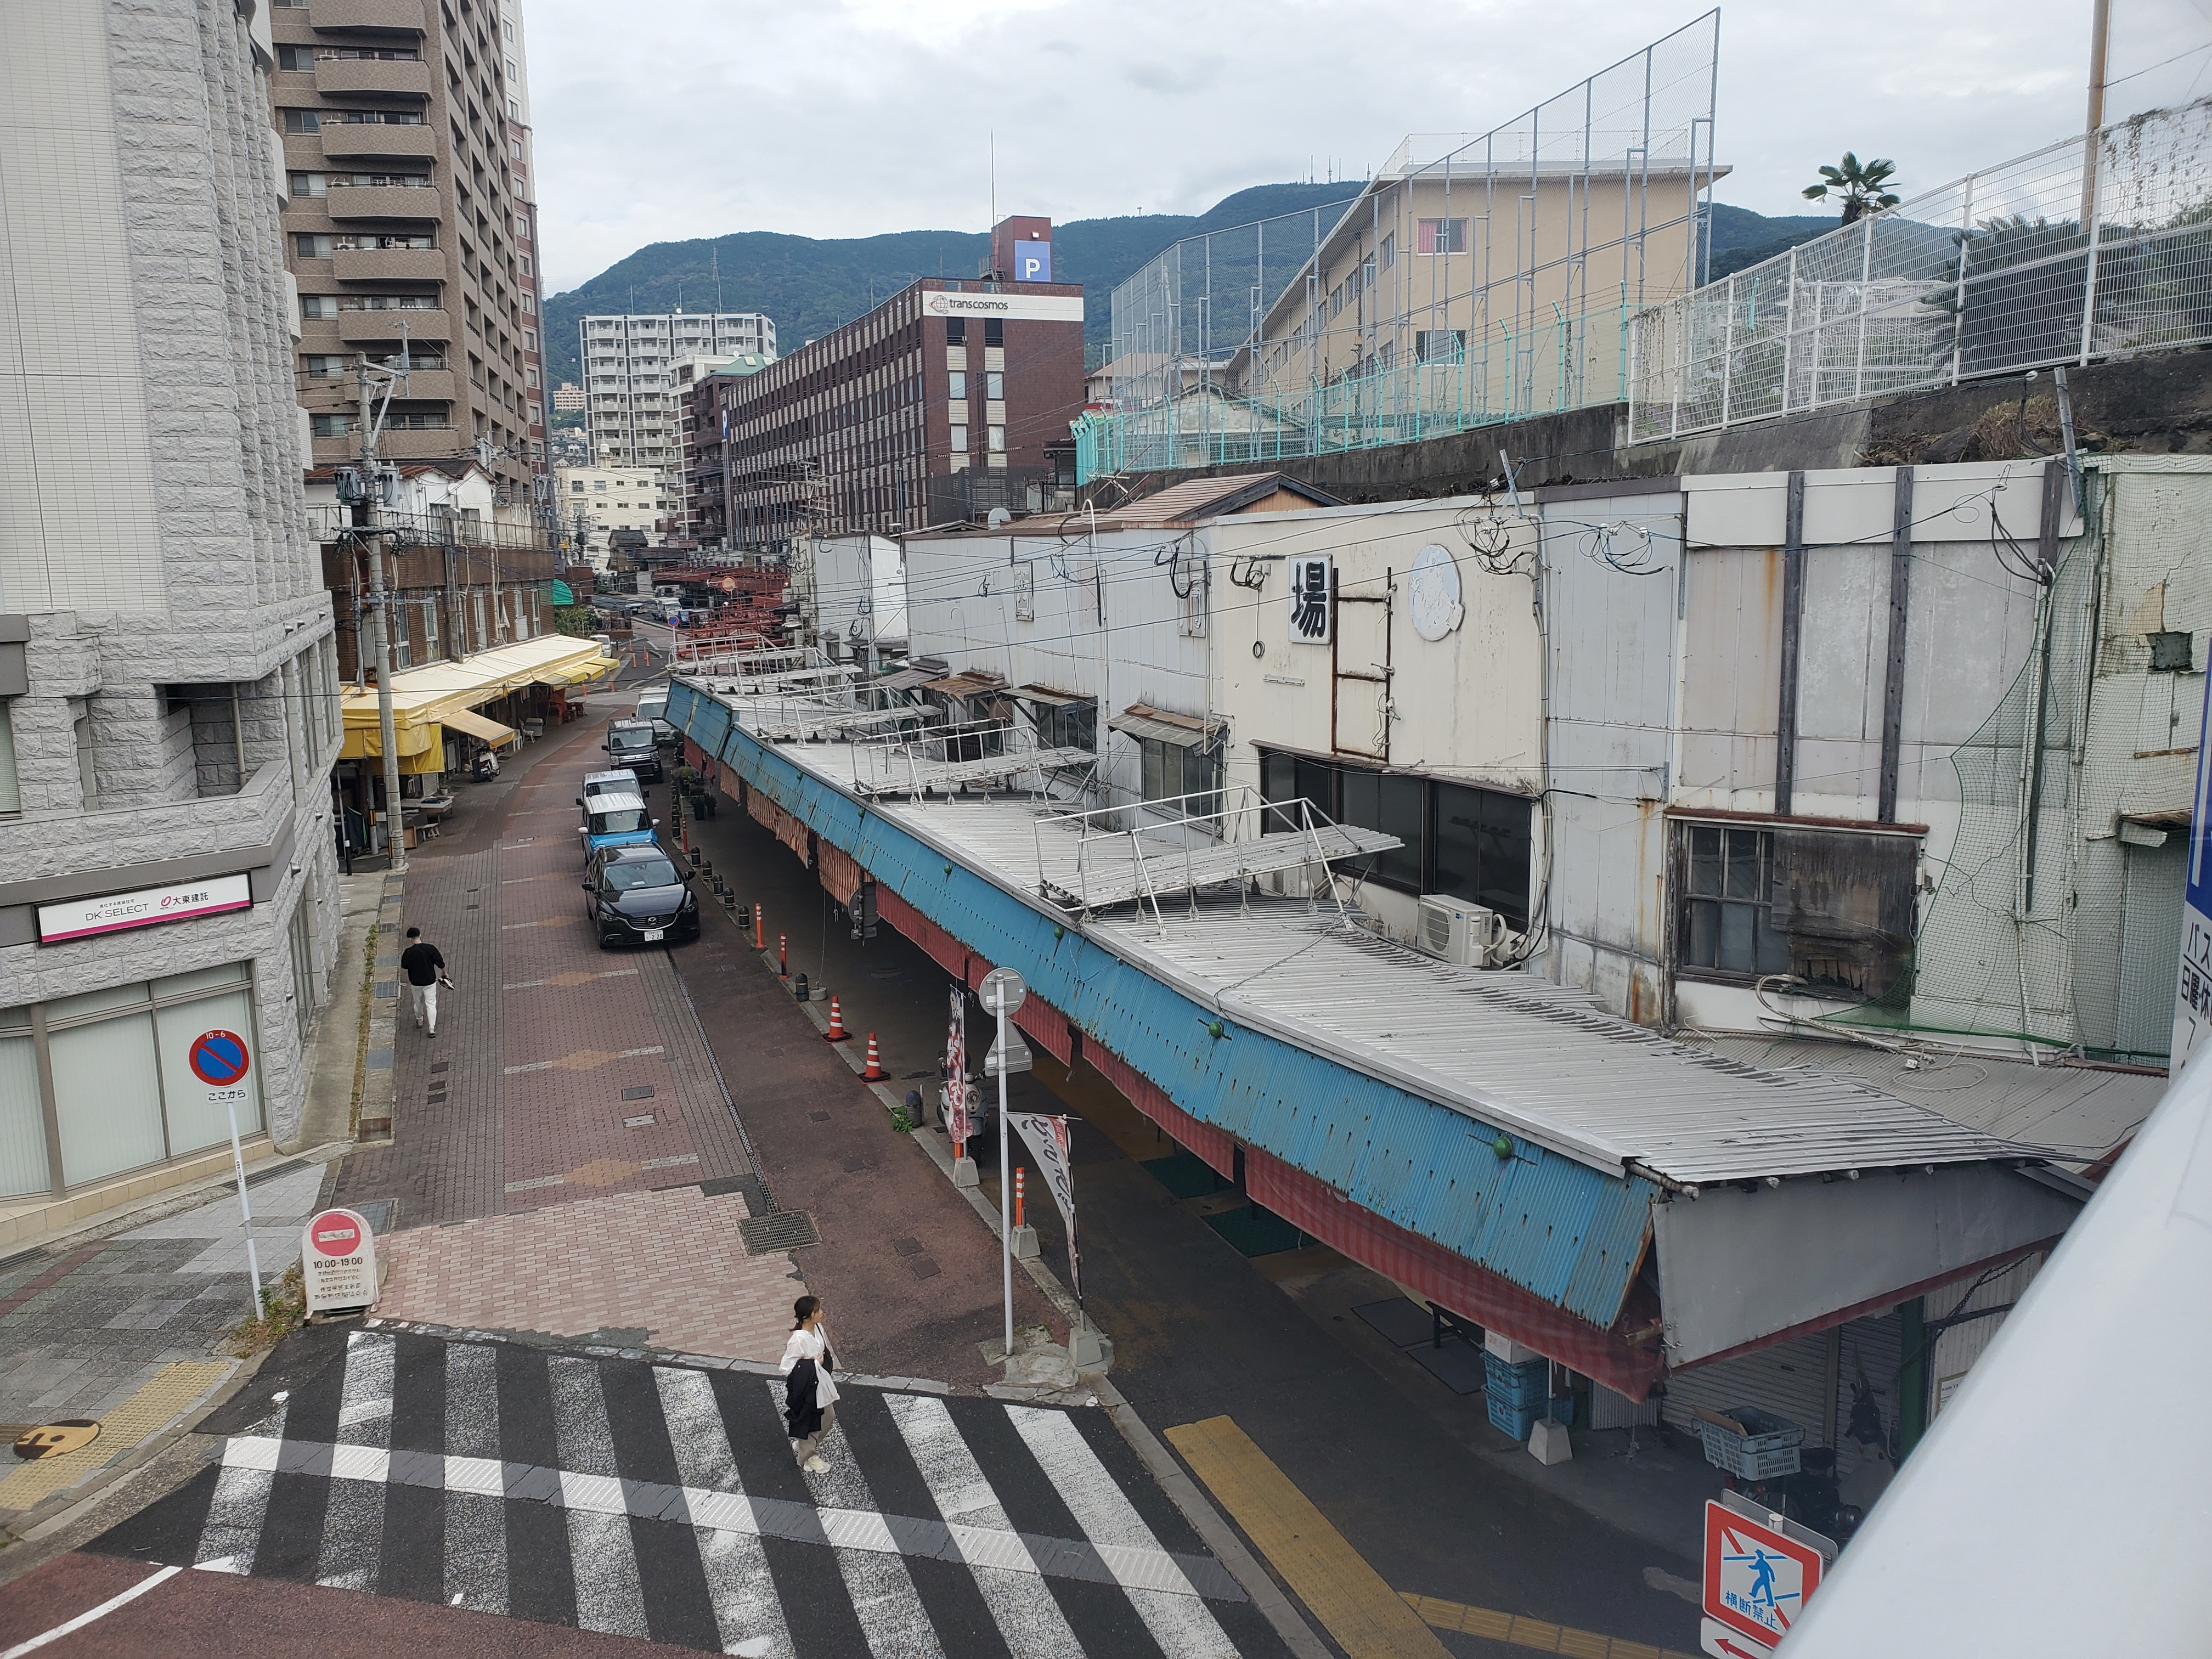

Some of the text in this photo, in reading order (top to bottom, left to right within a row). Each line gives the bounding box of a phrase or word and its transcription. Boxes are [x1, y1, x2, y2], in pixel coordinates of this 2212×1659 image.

[1025, 258, 1040, 279] P
[949, 298, 1008, 311] transcosmos
[722, 410, 727, 437] P
[1291, 561, 1327, 639] 場
[172, 892, 208, 906] 大東建託
[85, 903, 149, 921] DK SELECT
[2187, 922, 2211, 970] バス
[2181, 964, 2212, 1027] 日曜・休
[208, 1090, 246, 1101] ここから
[313, 1257, 363, 1269] 10:00-19:00
[1725, 1590, 1778, 1630] 横断禁止
